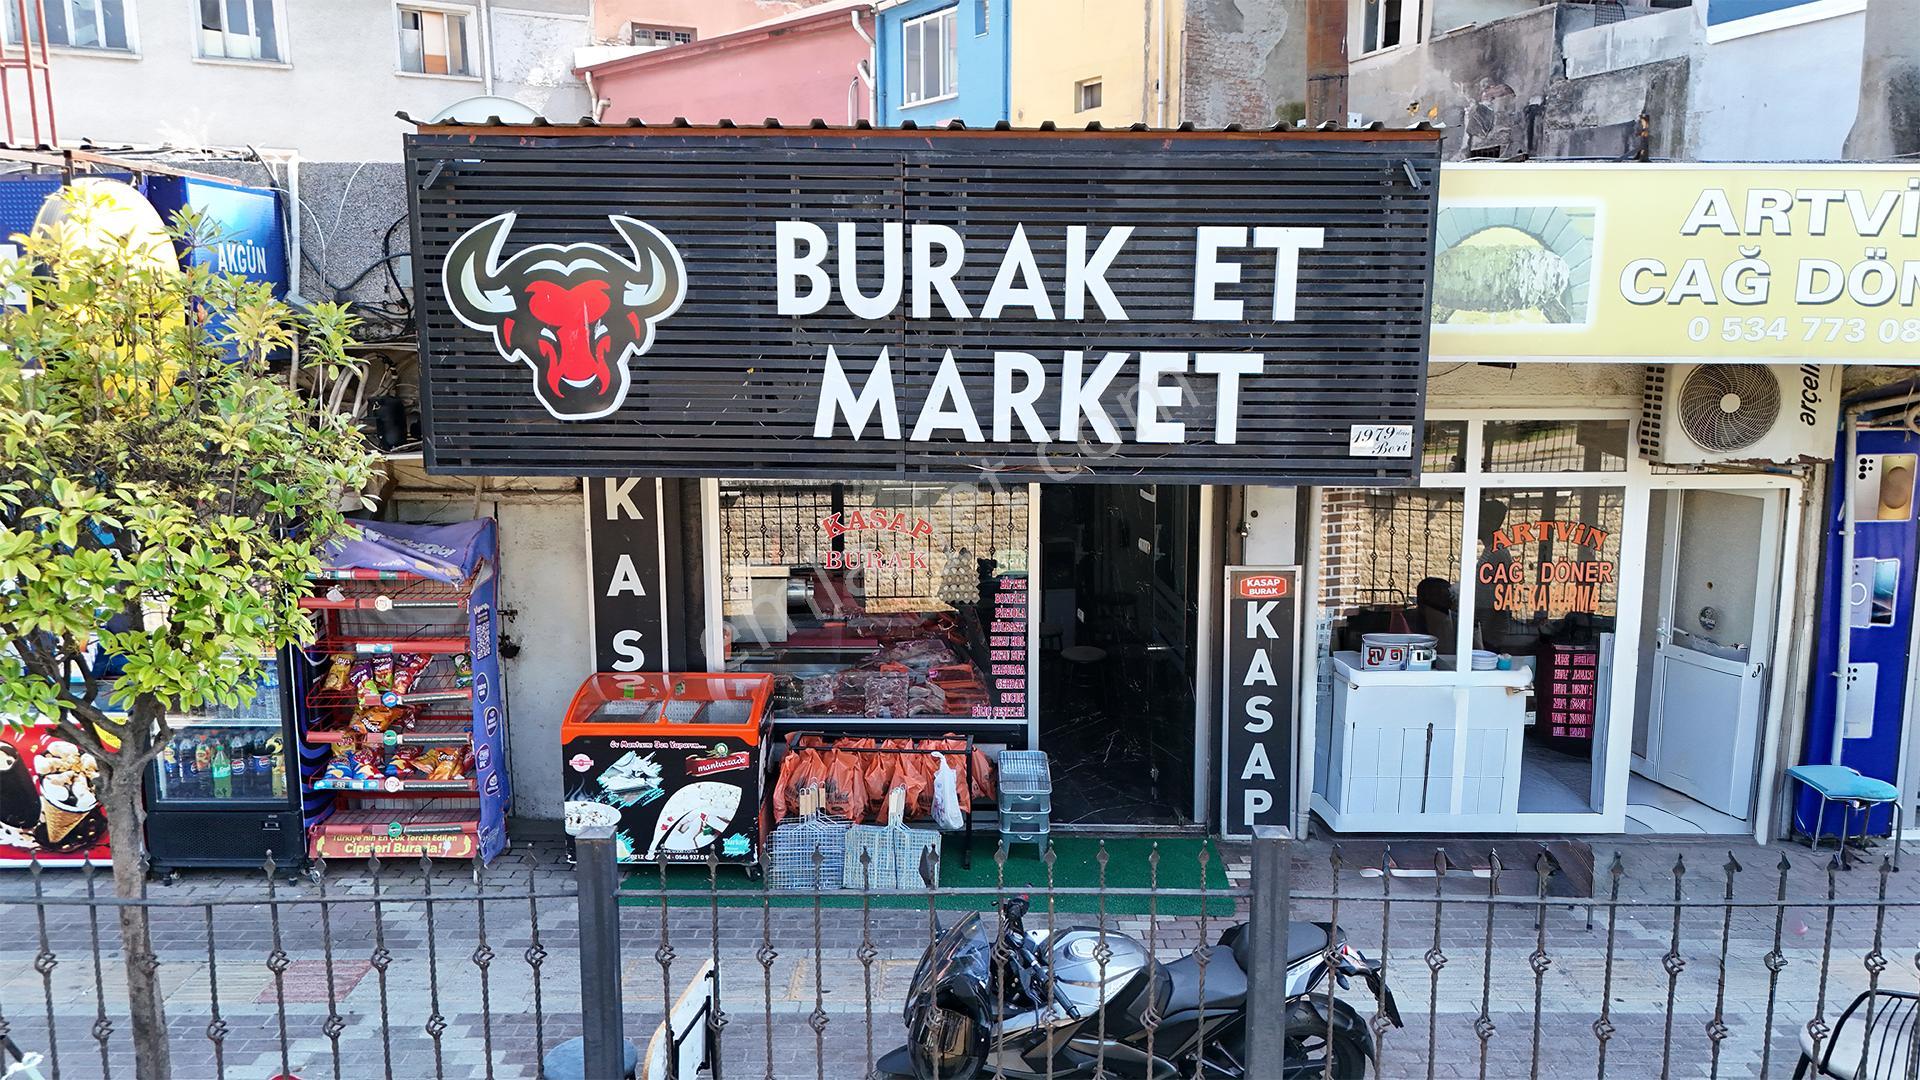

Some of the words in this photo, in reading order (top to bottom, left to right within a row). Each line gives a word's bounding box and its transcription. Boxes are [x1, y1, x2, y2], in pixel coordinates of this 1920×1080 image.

[218, 239, 267, 274] AKGÜN
[775, 221, 1135, 320] BURAK
[1192, 226, 1325, 321] ET
[1619, 245, 1771, 306] CAĞ
[1687, 316, 1710, 342] 0
[1721, 317, 1788, 342] 534
[1801, 317, 1867, 343] 773
[813, 344, 1264, 445] MARKET
[1352, 426, 1395, 443] 1979
[1372, 441, 1408, 454] Beri
[822, 508, 933, 539] KASAP
[825, 549, 928, 569] BURAK
[1479, 556, 1524, 584] CAĞ
[1541, 556, 1614, 583] DÖNER
[1247, 578, 1280, 587] KASAP
[1241, 601, 1279, 825] KASAP
